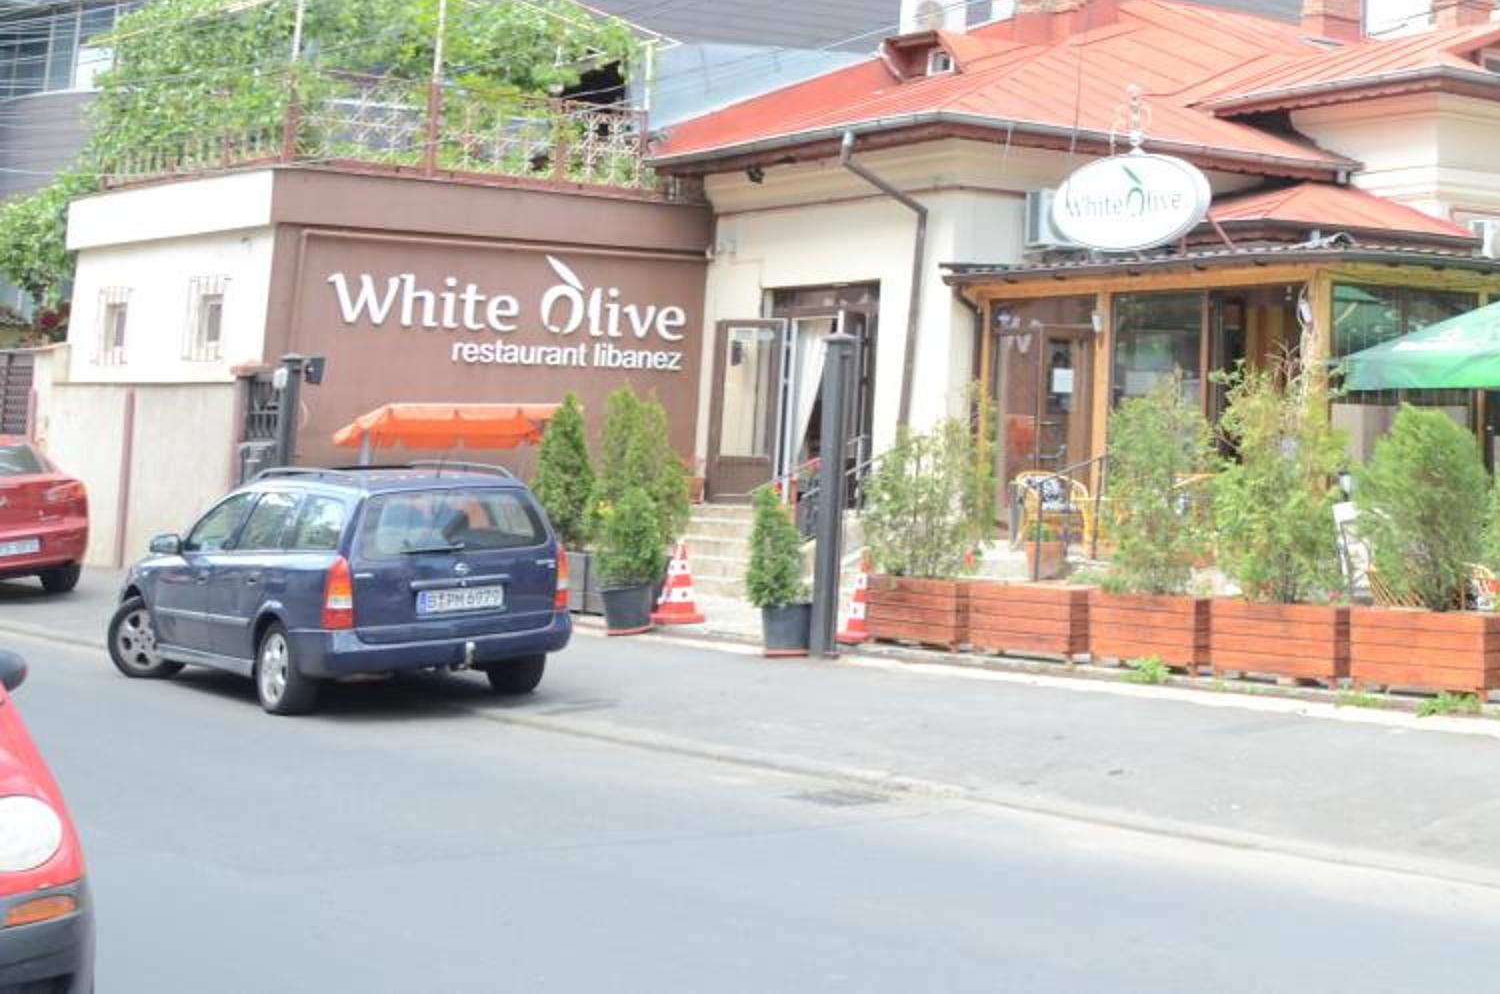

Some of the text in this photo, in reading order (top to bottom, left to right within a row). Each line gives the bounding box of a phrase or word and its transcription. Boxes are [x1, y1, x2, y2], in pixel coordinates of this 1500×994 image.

[1065, 189, 1122, 218] White
[327, 272, 686, 341] White Olive
[452, 339, 683, 370] restaurant libanez
